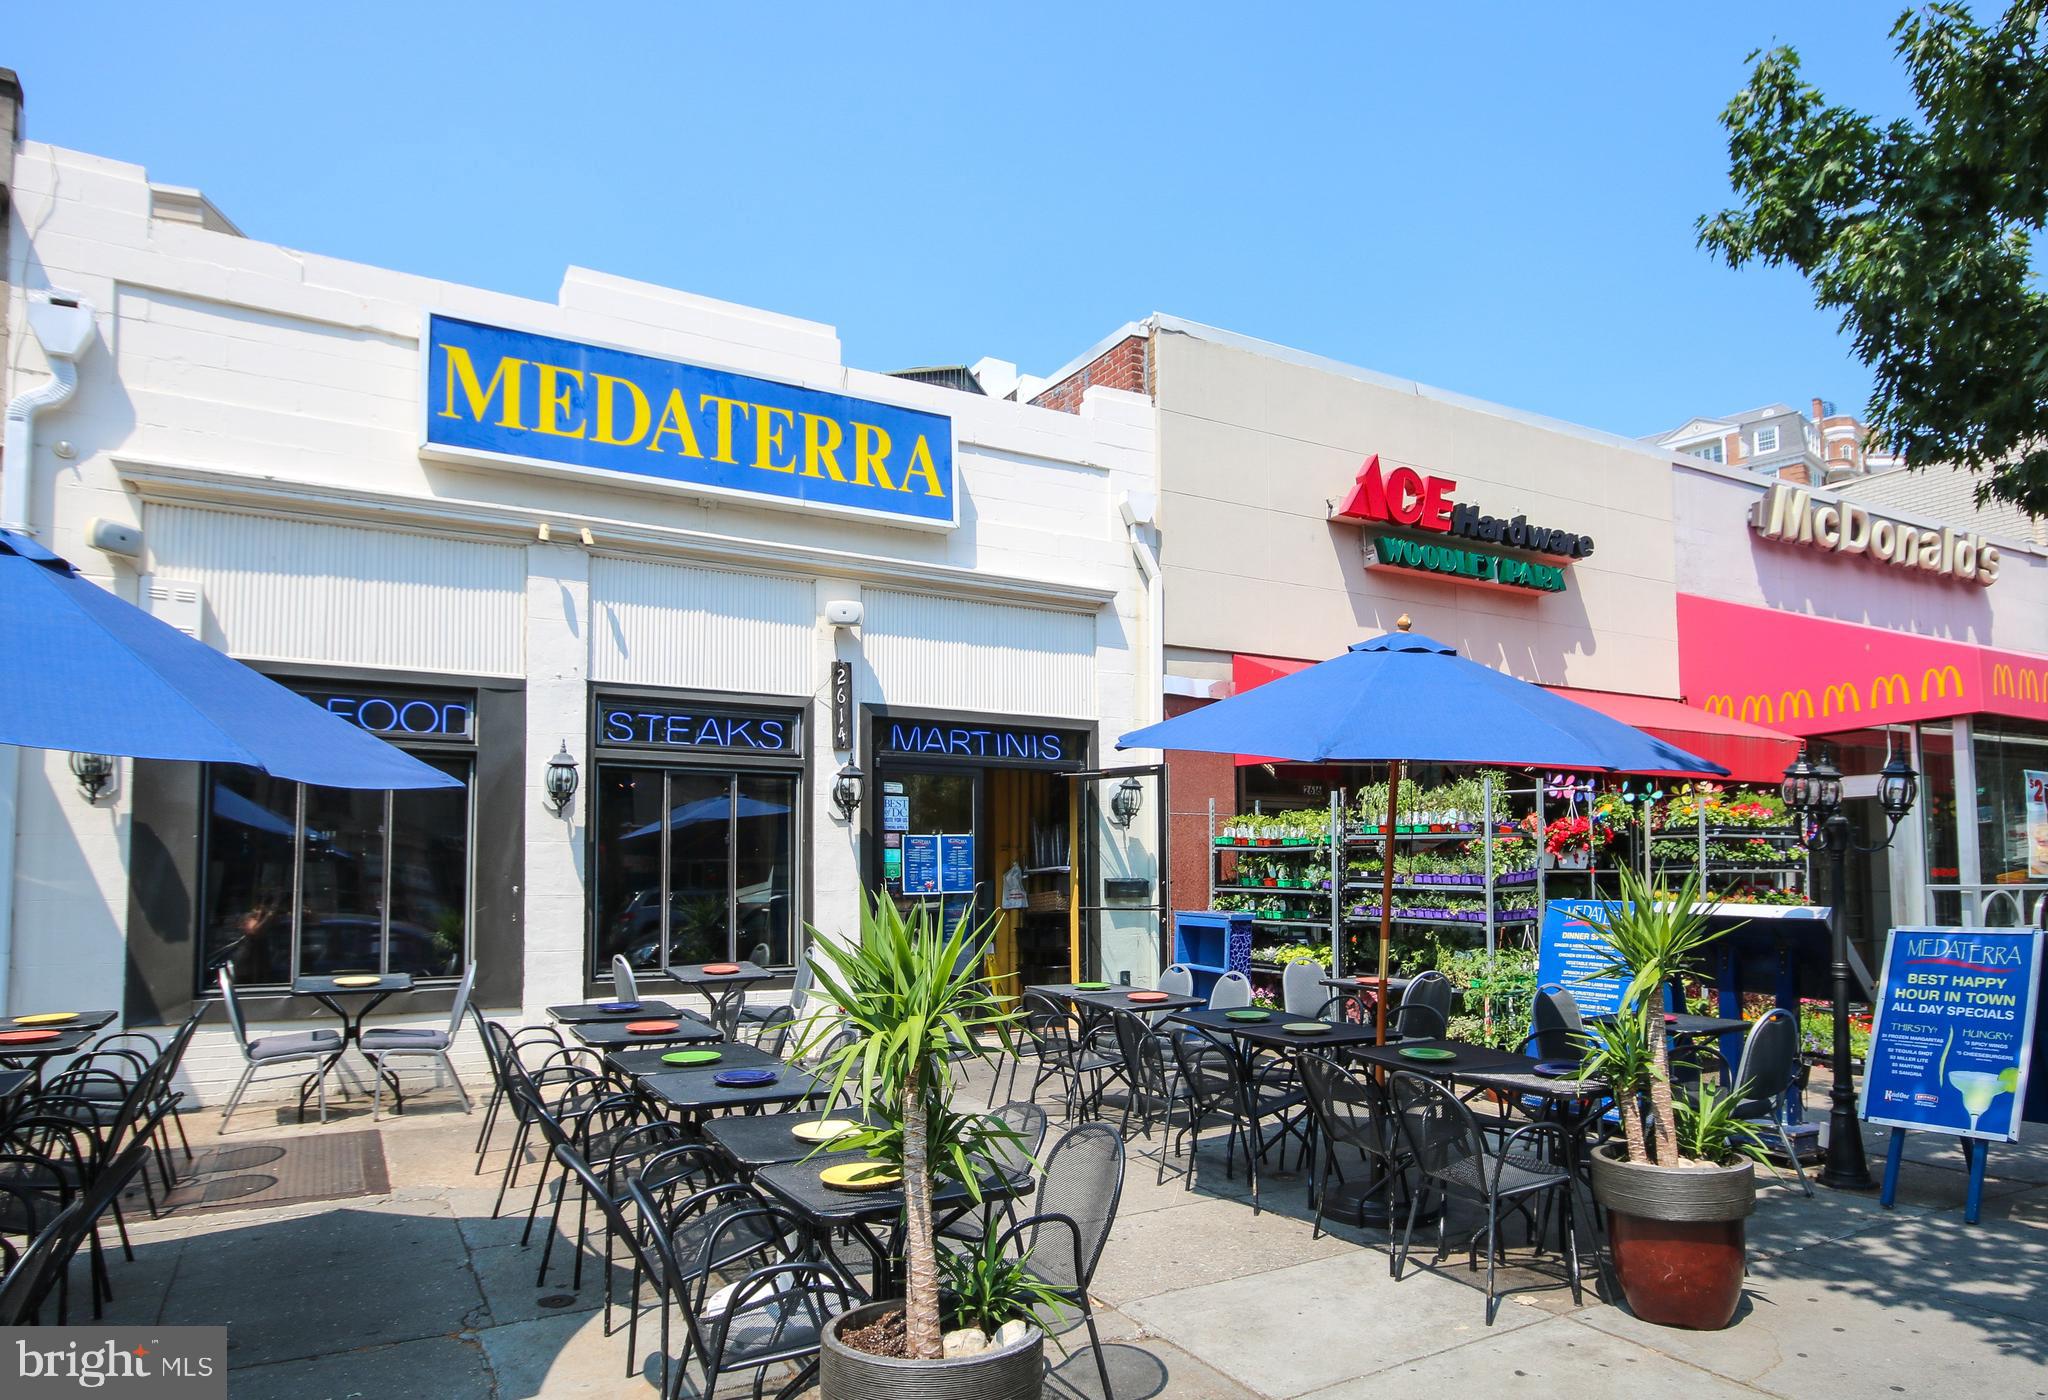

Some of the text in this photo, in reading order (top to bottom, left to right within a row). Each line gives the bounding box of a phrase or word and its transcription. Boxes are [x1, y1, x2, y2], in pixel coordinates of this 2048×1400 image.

[437, 343, 947, 498] MEDATERRA
[1339, 453, 1595, 558] ACE Hardware
[1762, 483, 2000, 587] McDonald's
[1376, 535, 1566, 592] WOODLEY PARK
[836, 669, 847, 742] 2614
[607, 711, 783, 750] STEAKS
[892, 724, 1061, 760] MARTINIS
[884, 799, 907, 808] BEST
[892, 807, 908, 817] DC
[1562, 931, 1590, 940] DINNER
[1907, 938, 2022, 965] MEDATERRA
[1907, 973, 2007, 989] BEST HAPPY
[1894, 987, 2016, 1007] HOUR IN TOWN
[1891, 1002, 2015, 1021] ALL DAY SPECIALS
[1890, 1022, 1938, 1034] THIRSTY?
